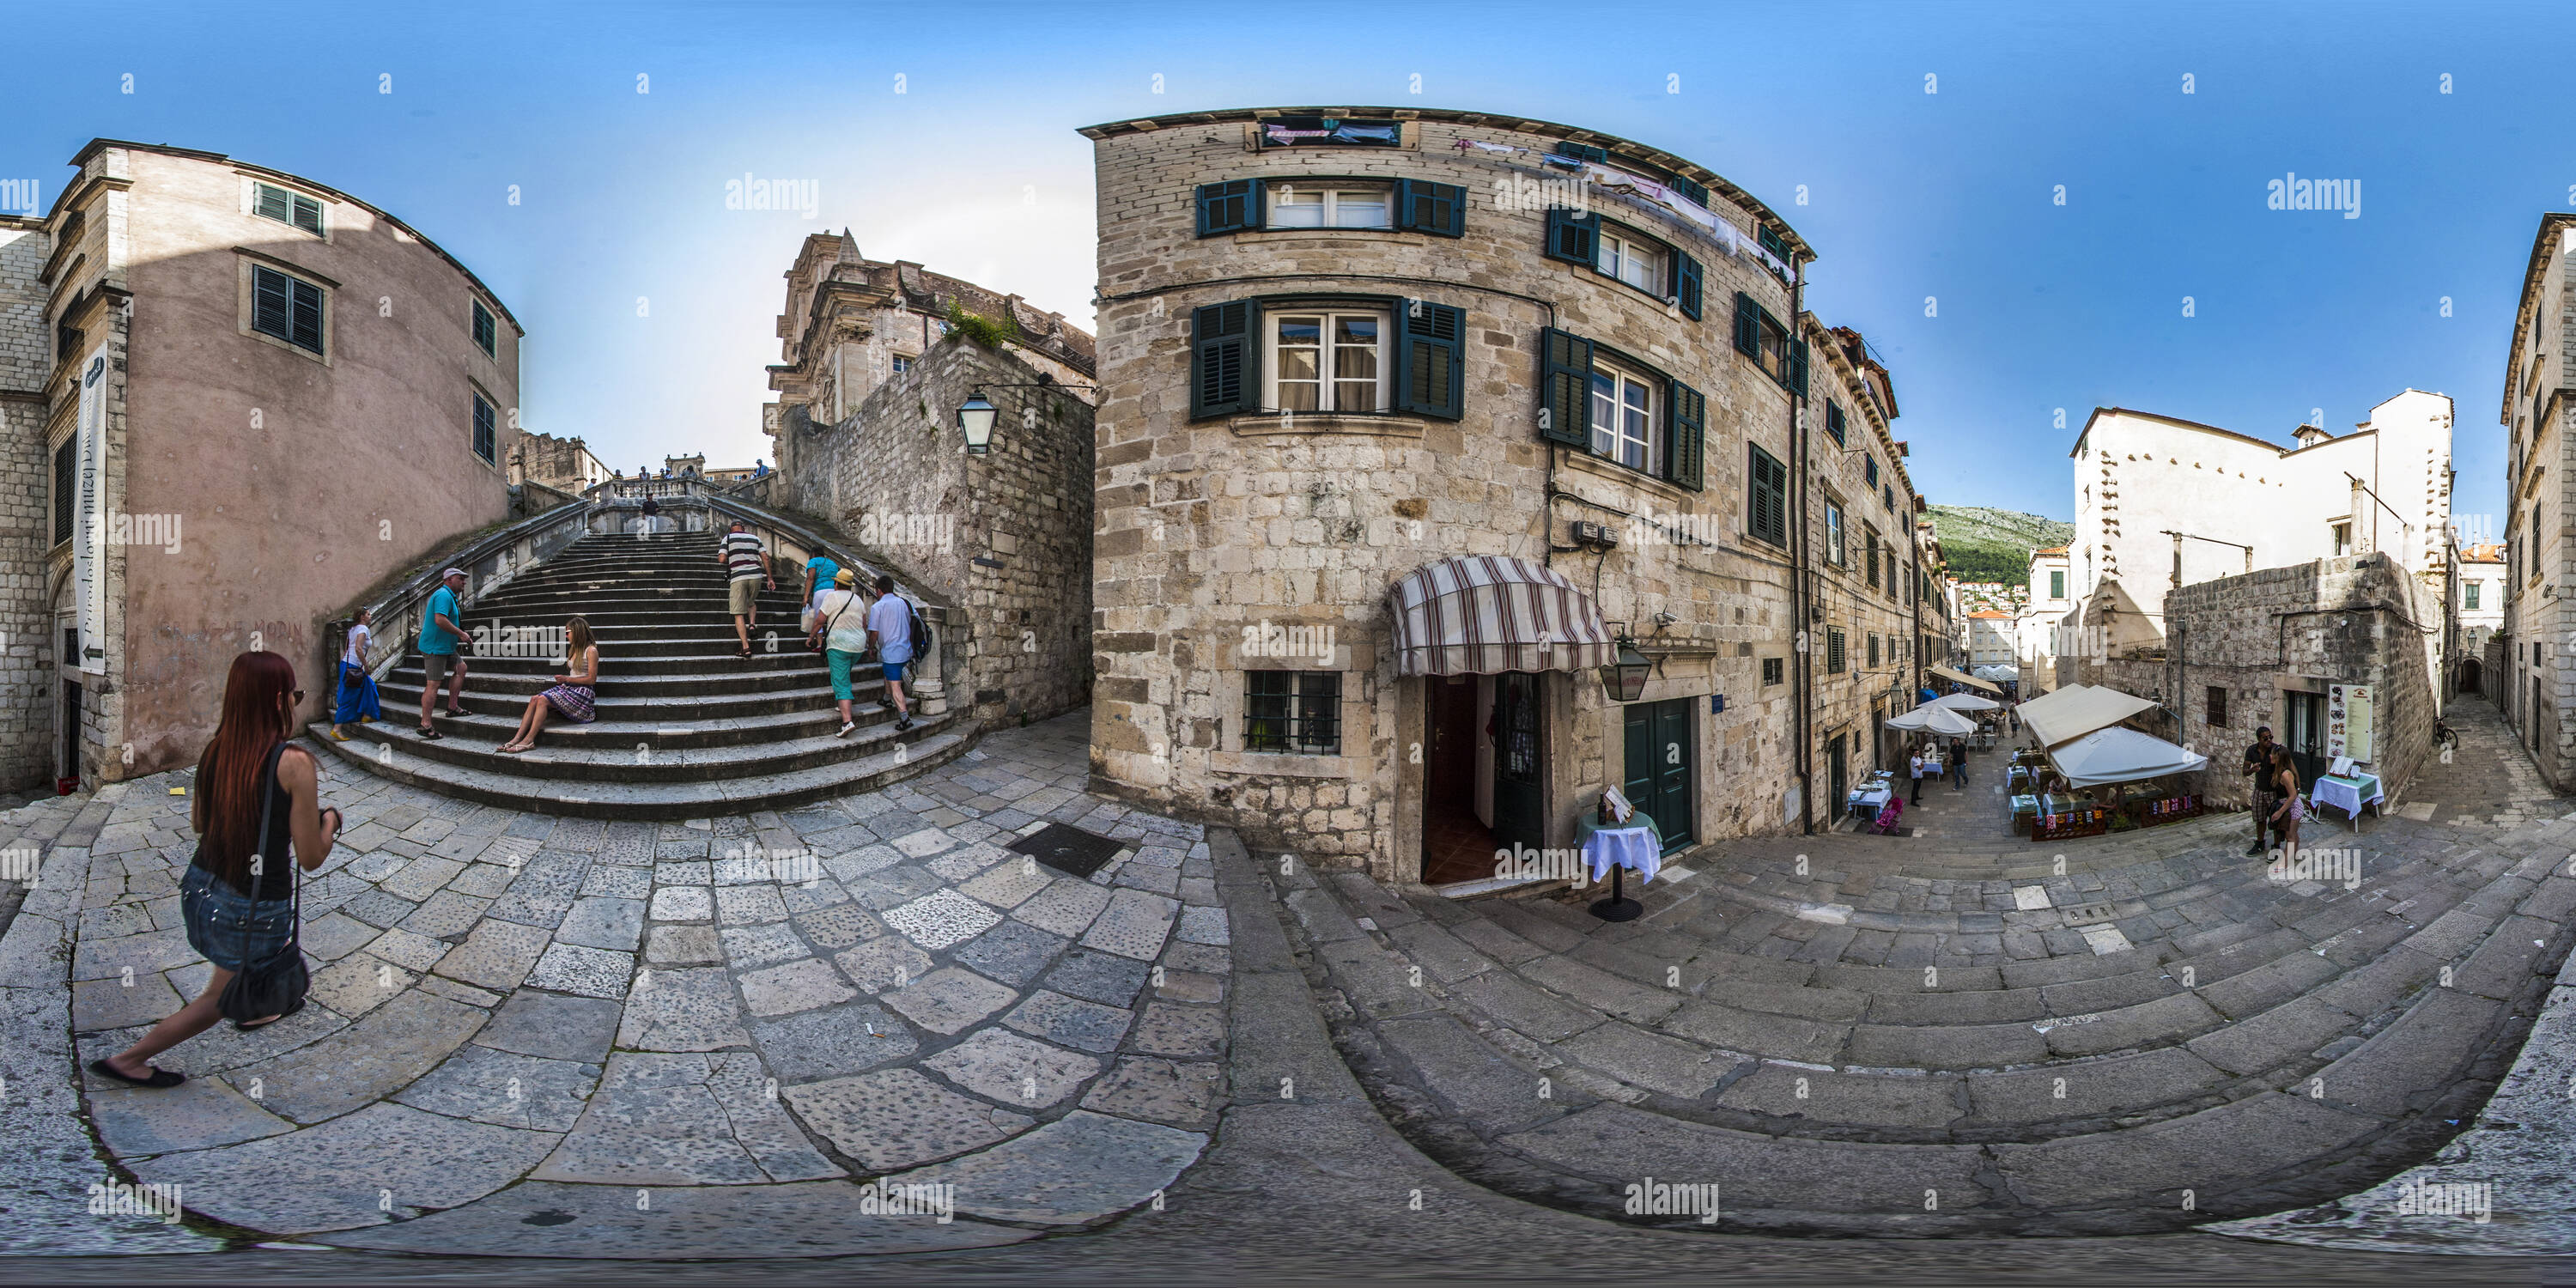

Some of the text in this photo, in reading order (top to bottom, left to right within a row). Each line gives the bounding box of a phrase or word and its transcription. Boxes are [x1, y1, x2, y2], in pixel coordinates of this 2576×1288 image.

[80, 392, 96, 634] Prirodoslovni muzej Dubrovnik
